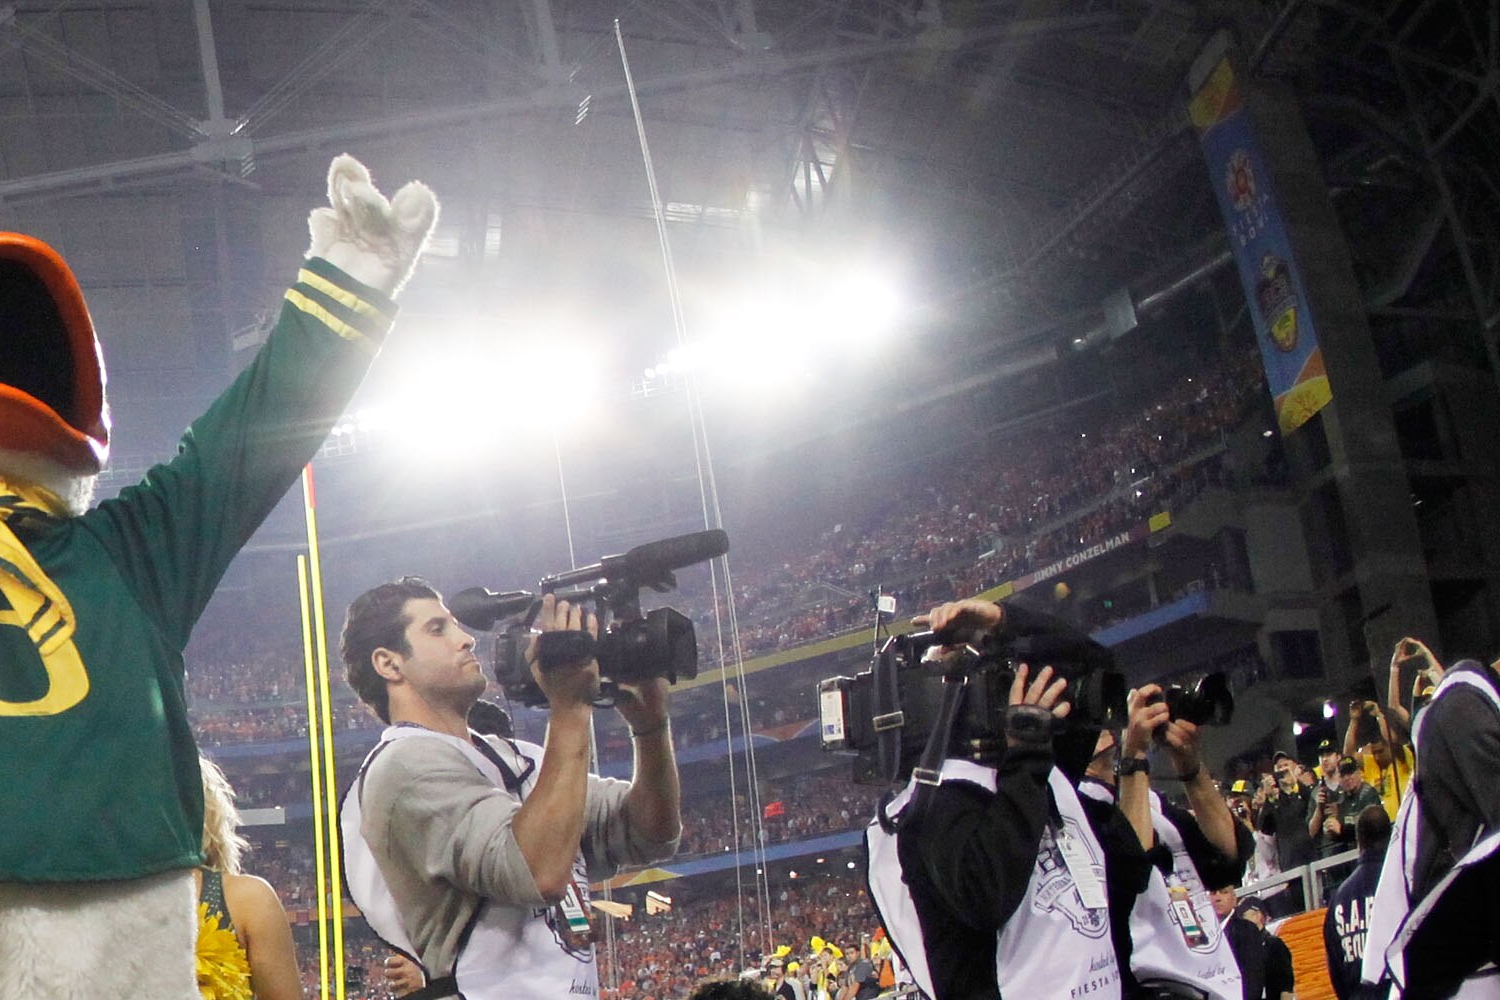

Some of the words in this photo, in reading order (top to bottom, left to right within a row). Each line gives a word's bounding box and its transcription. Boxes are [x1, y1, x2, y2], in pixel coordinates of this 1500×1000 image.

[1033, 561, 1064, 583] JIMMY
[1065, 531, 1131, 568] CONZELMAN
[1070, 977, 1110, 999] FIESTA
